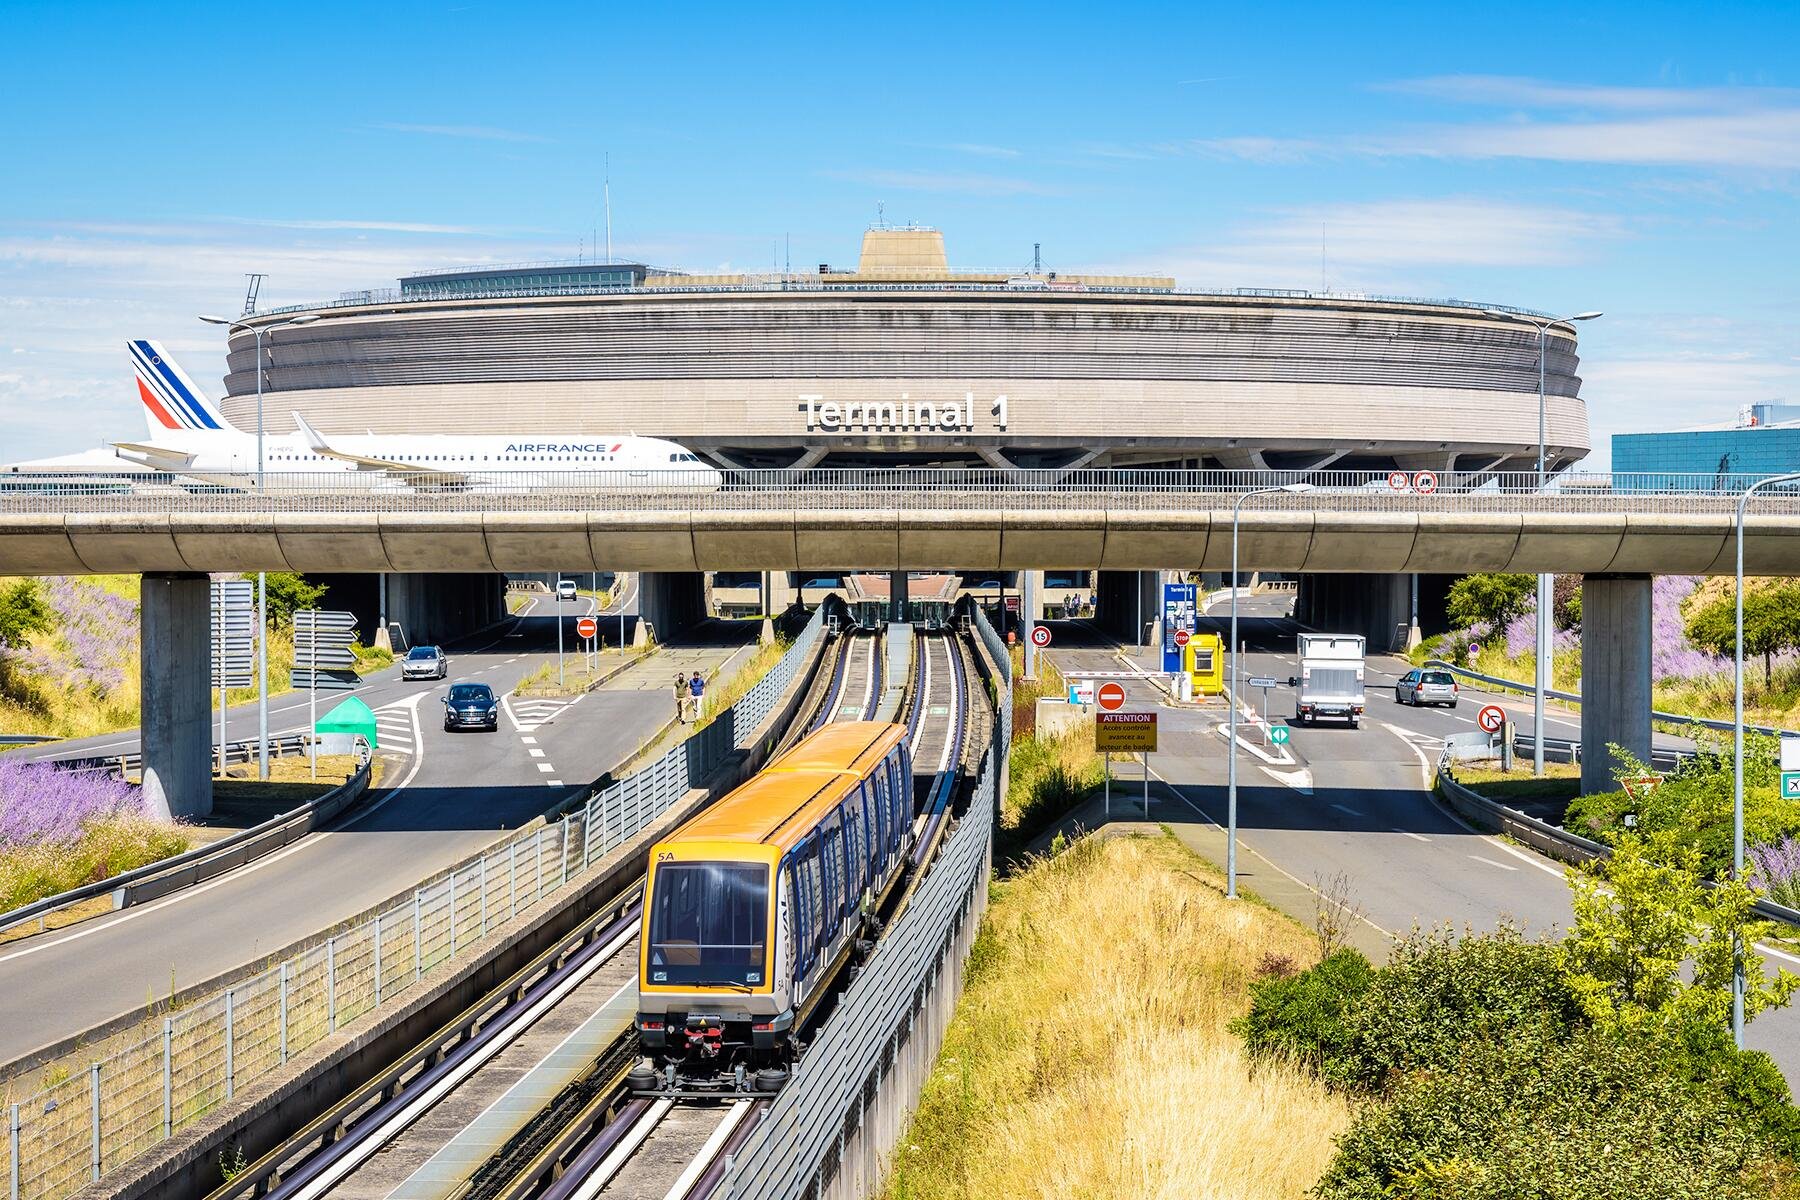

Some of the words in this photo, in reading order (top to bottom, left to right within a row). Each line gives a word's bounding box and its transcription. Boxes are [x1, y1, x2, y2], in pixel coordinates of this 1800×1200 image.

[798, 392, 974, 428] Terminal
[992, 394, 1008, 427] 1
[505, 443, 606, 452] AIRFRANCE
[1188, 586, 1193, 599] 1
[1103, 714, 1150, 722] ATTENTION
[658, 852, 675, 861] 5A
